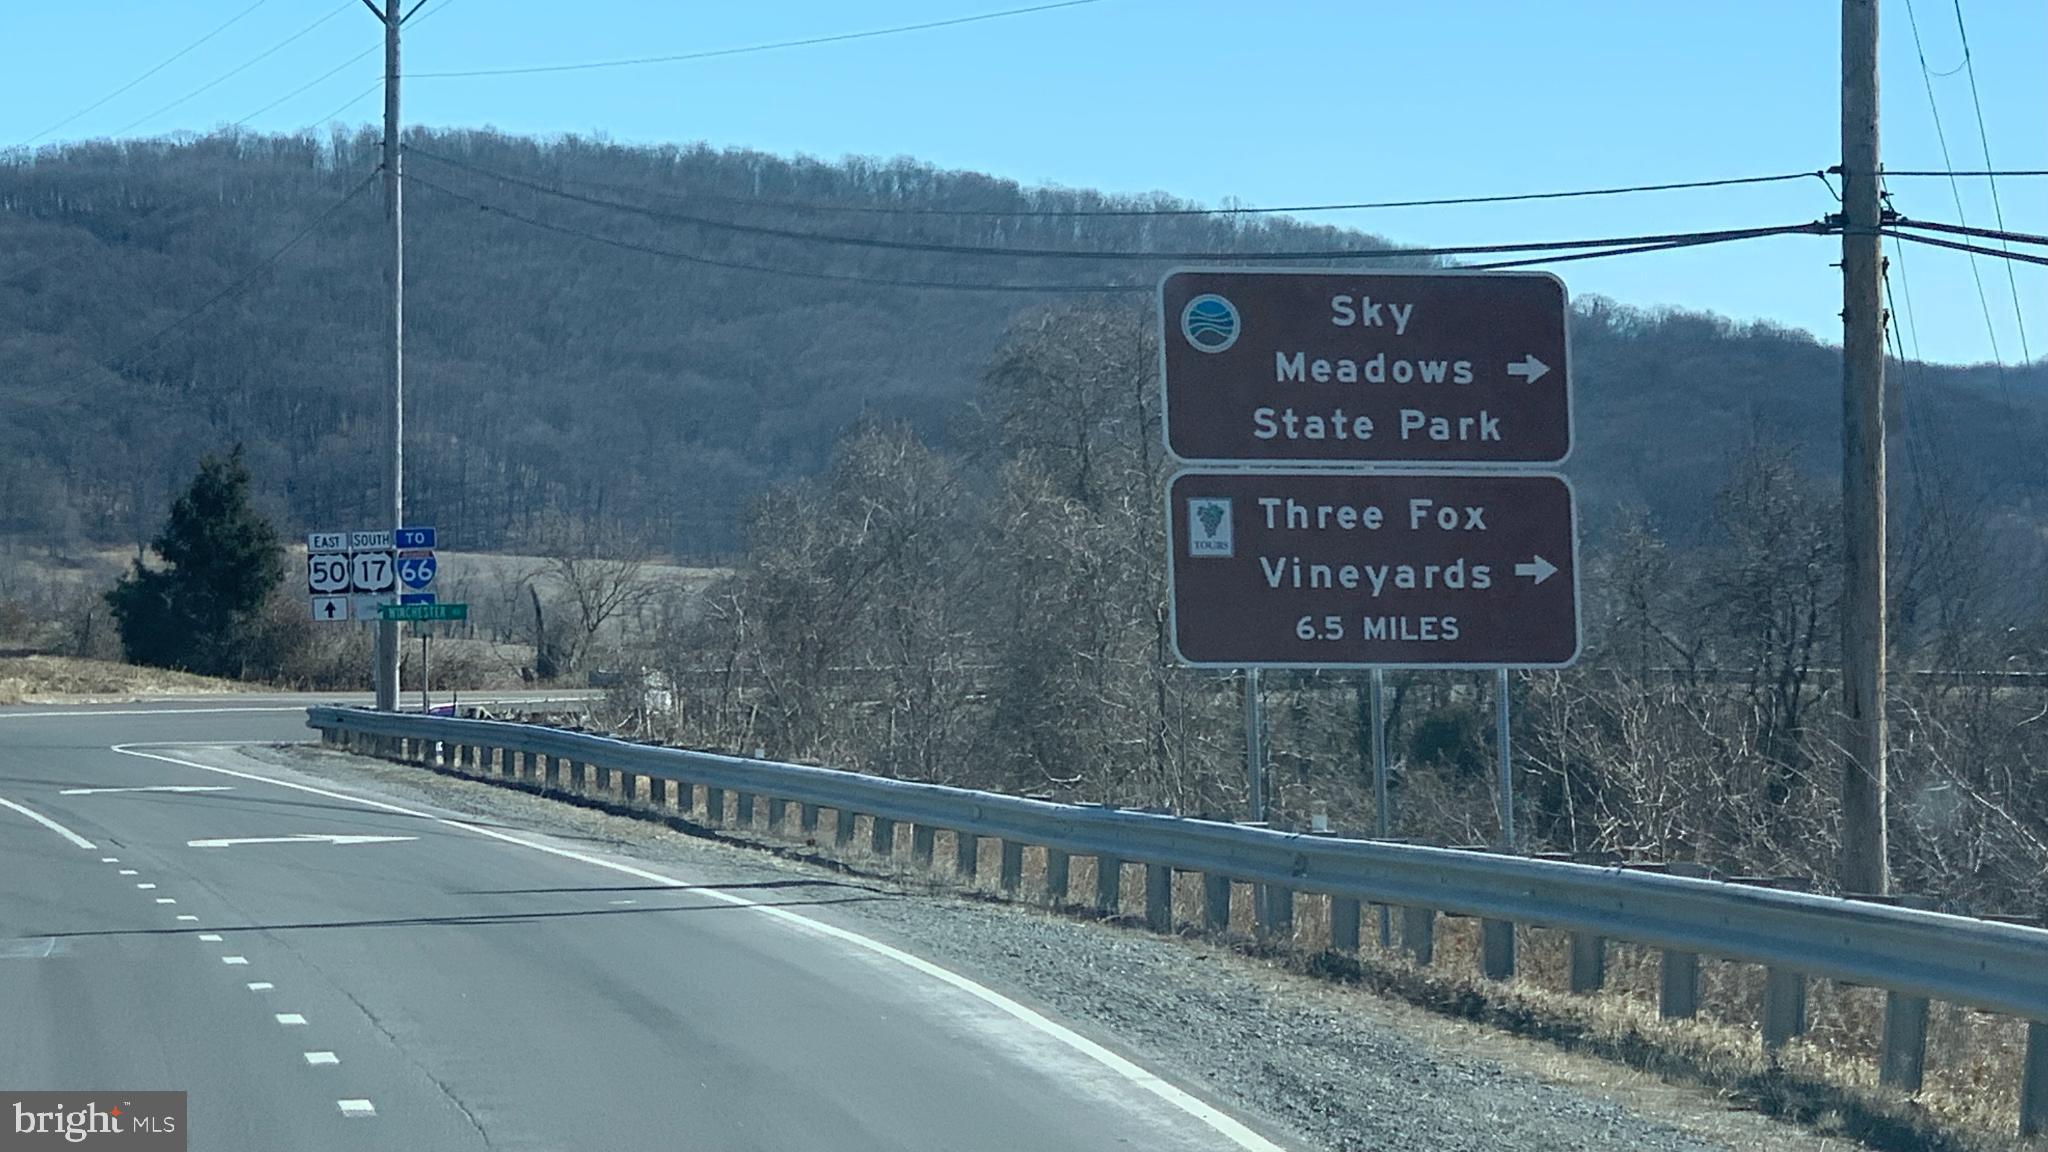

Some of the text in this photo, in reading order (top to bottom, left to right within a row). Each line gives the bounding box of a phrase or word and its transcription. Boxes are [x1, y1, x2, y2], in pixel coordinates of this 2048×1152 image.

[1331, 295, 1413, 335] Sky
[1275, 351, 1474, 384] Meadows
[1253, 407, 1501, 441] State Park
[1258, 497, 1487, 530] Three Fox
[314, 535, 340, 548] EAST
[353, 533, 390, 546] SOUTH
[405, 532, 425, 544] TO
[1193, 540, 1230, 550] TOURS
[313, 561, 346, 583] 50
[361, 560, 386, 582] 17
[401, 559, 433, 581] 66
[1258, 556, 1492, 597] Vineyards
[388, 606, 446, 618] WINCHESTER
[1296, 616, 1459, 641] 6.5 MILES
